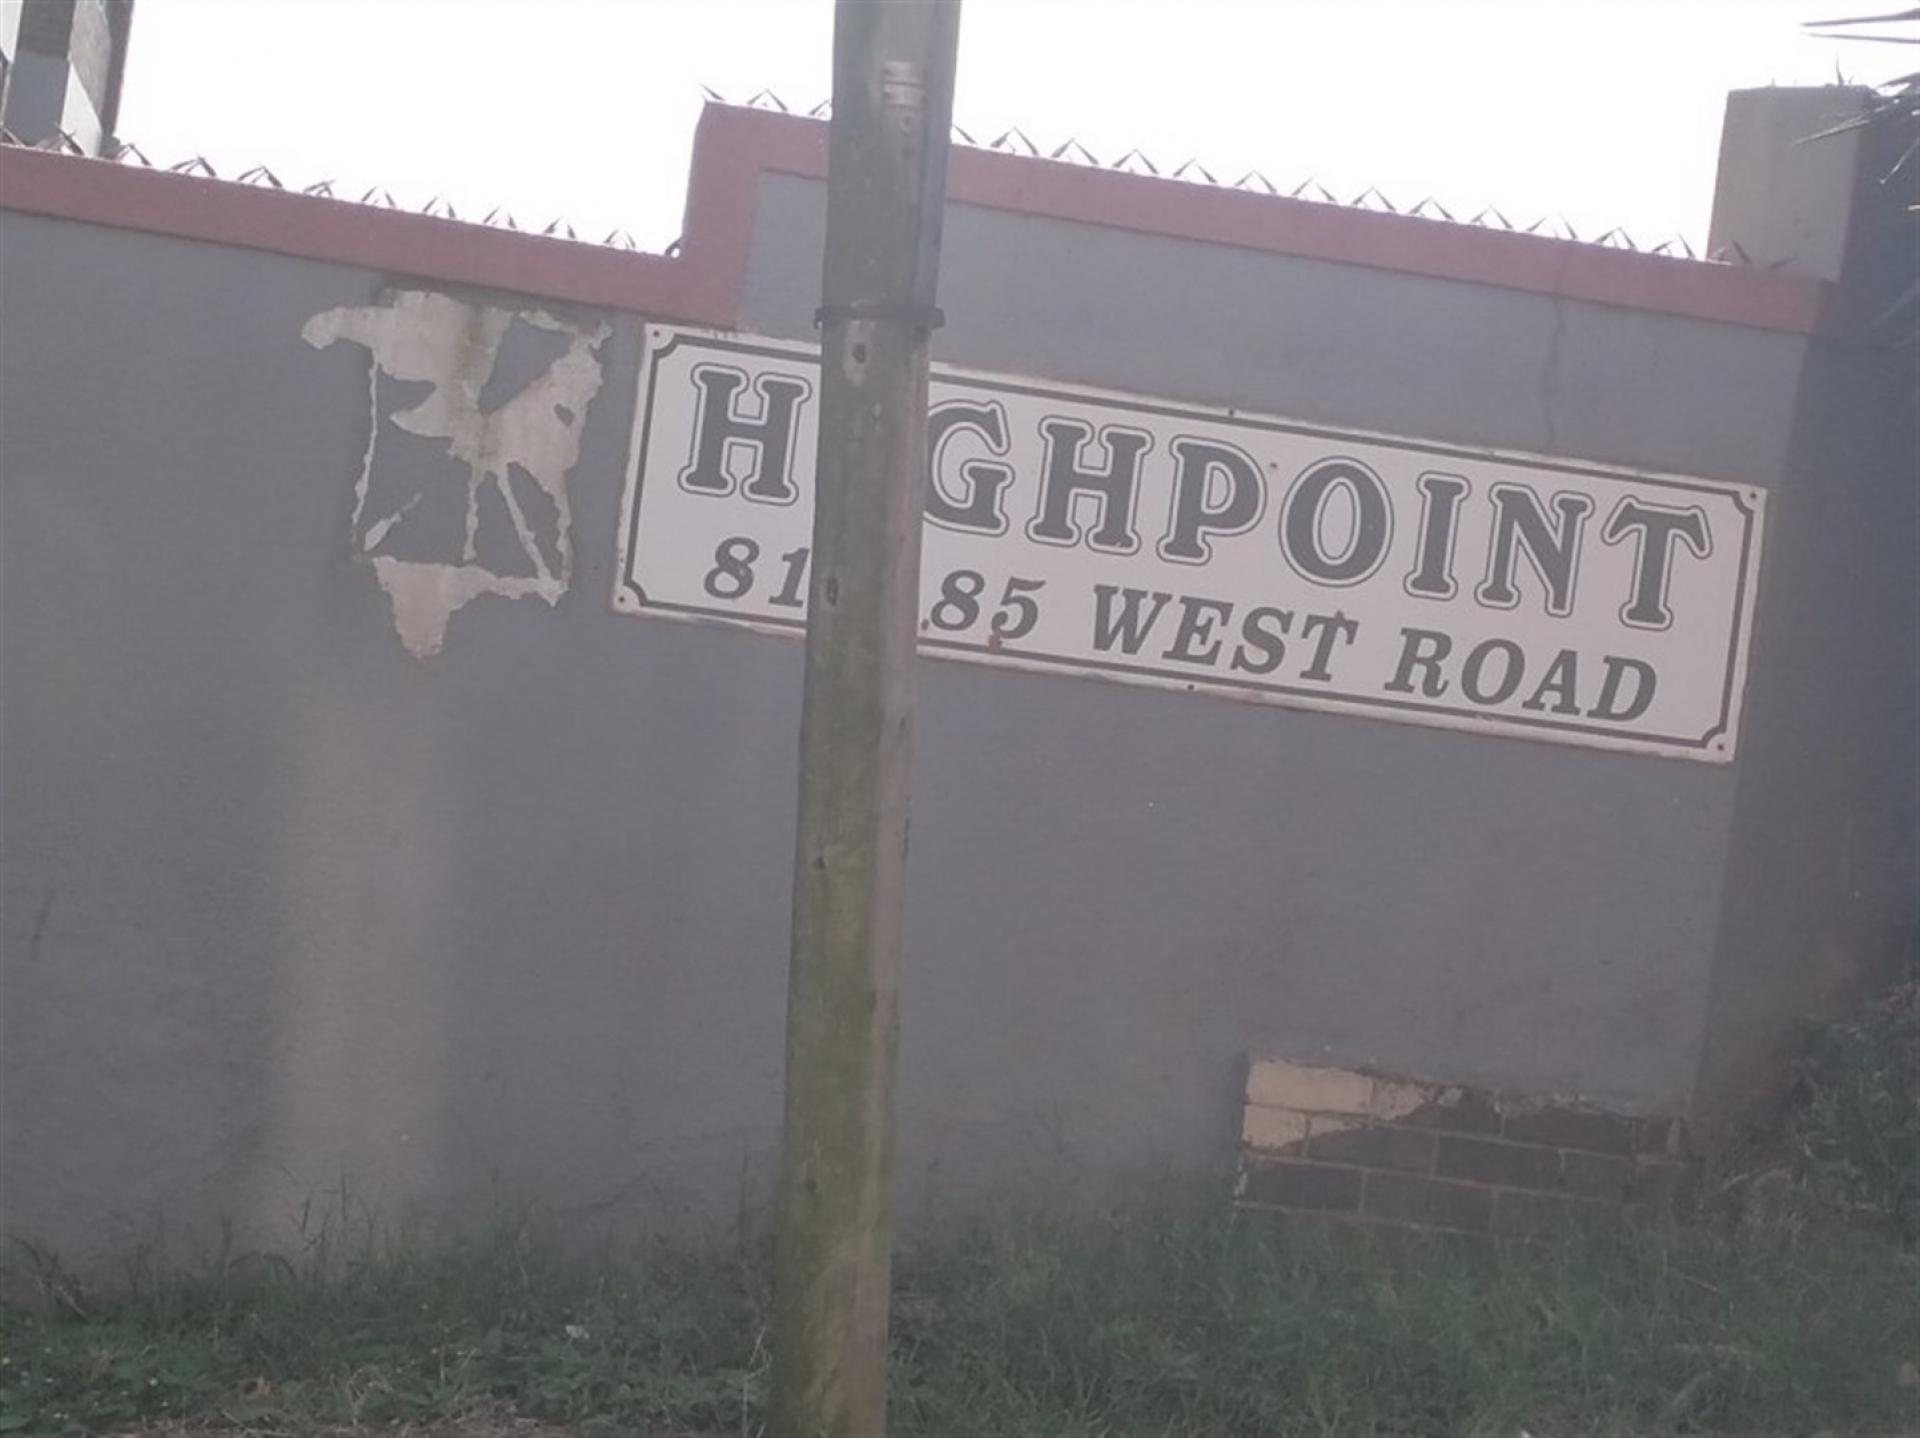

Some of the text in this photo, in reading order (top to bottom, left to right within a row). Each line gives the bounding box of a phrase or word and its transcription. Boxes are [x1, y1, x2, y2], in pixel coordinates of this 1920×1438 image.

[678, 361, 1712, 631] HGHPOINT
[1093, 584, 1358, 682] WEST
[1384, 627, 1657, 722] ROAD
